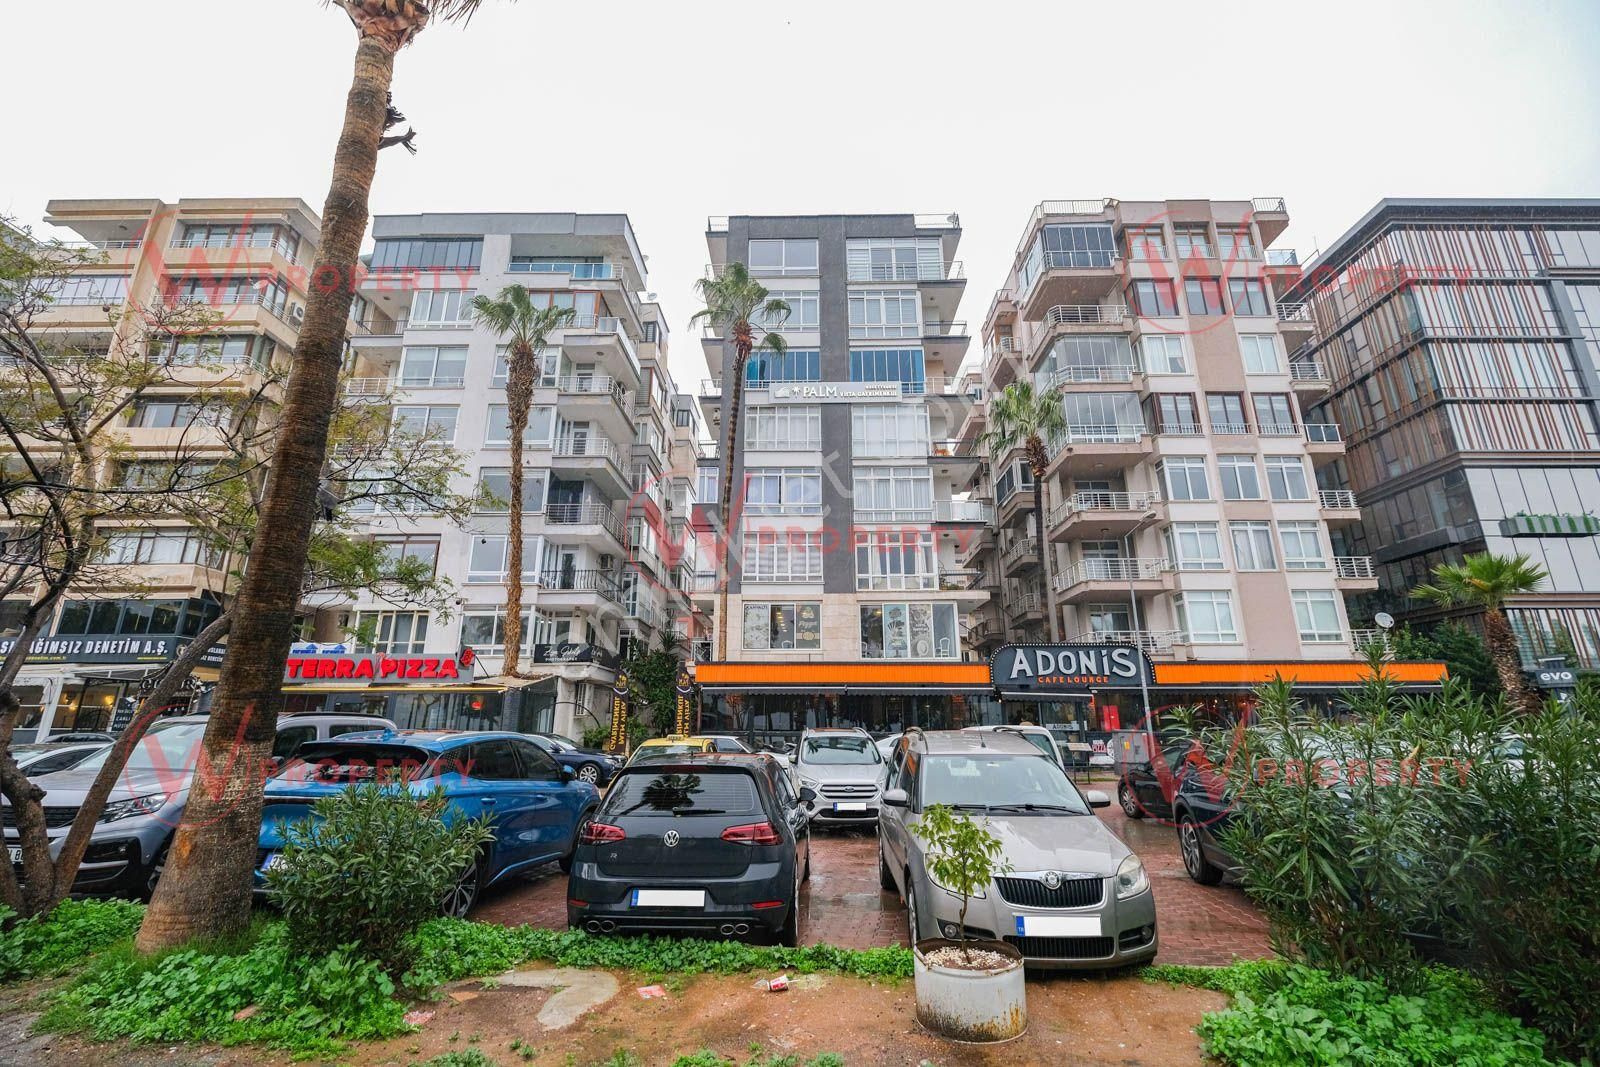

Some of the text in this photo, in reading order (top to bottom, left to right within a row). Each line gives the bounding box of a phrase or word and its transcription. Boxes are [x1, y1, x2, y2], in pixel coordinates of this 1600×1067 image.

[803, 386, 837, 397] PALM
[84, 637, 140, 654] DENETİM
[143, 640, 168, 656] A.Ş.
[287, 658, 459, 679] TERRA PIZZA
[1540, 671, 1572, 681] evo
